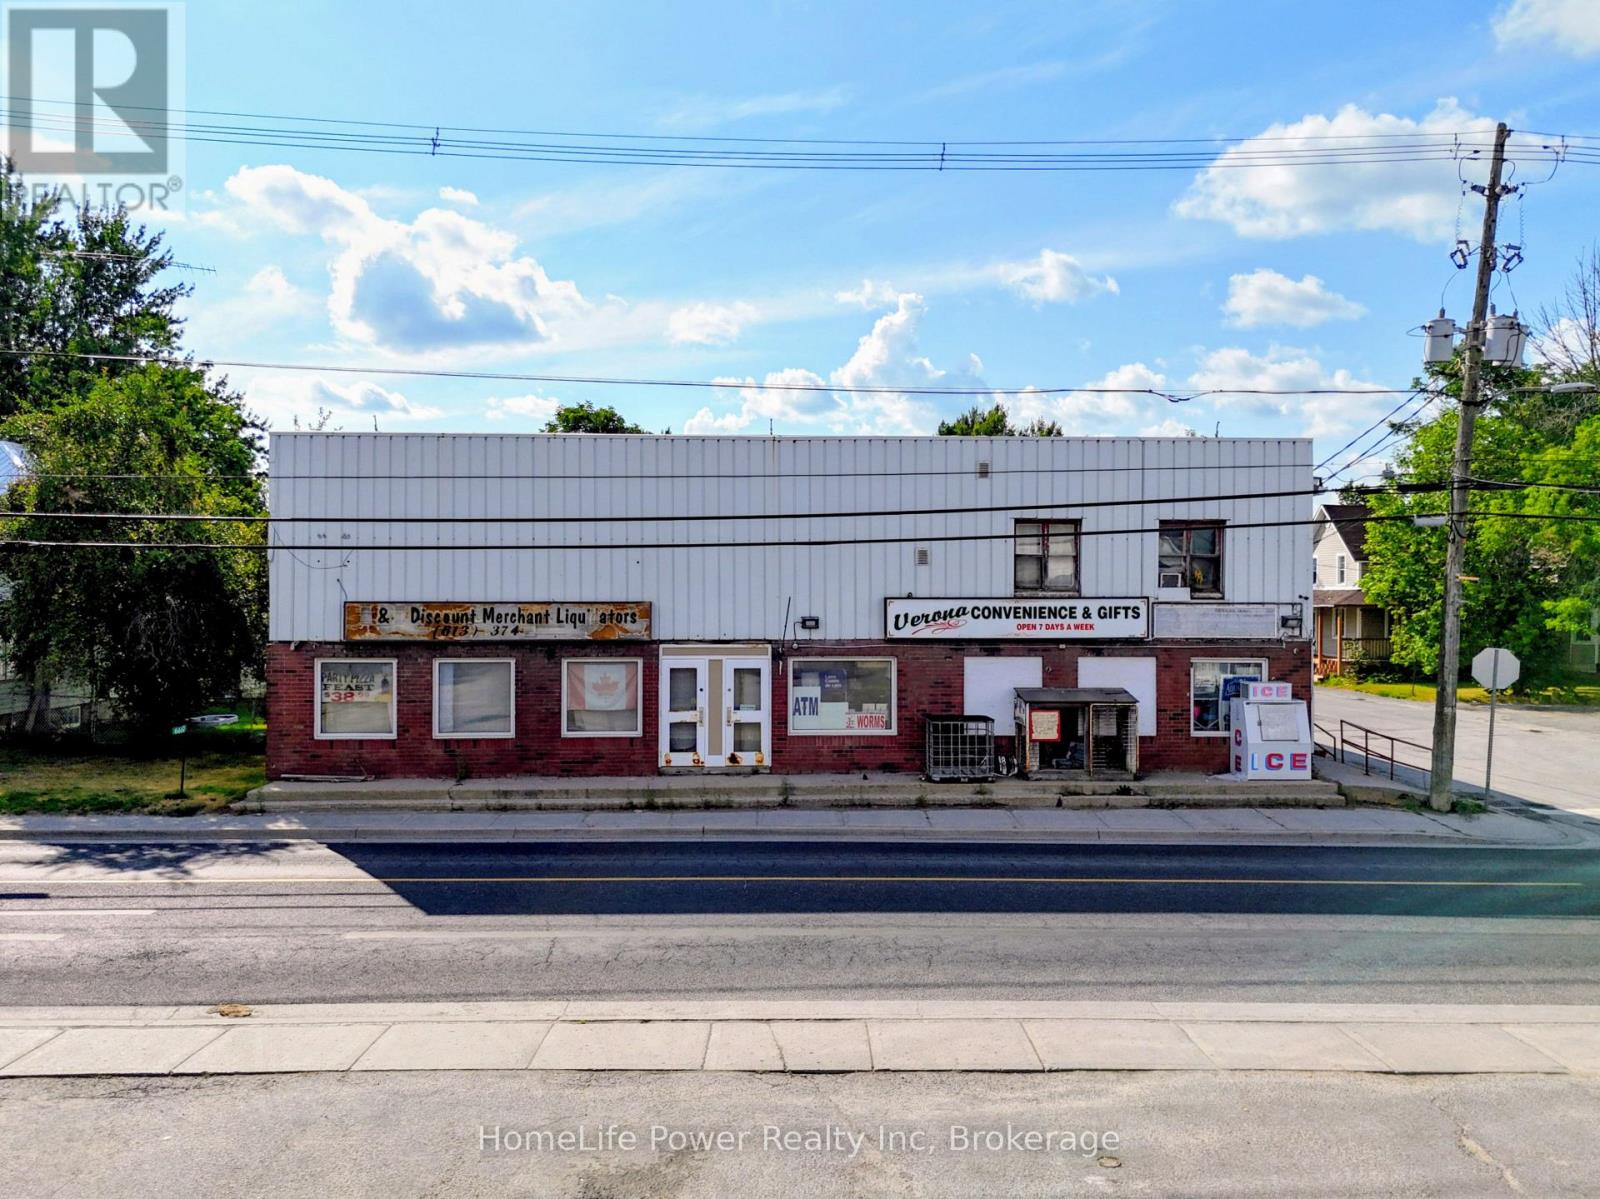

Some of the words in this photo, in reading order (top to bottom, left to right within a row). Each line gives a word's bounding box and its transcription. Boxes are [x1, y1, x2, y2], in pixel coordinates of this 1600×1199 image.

[410, 606, 477, 625] Discount
[482, 606, 551, 625] Merchant
[556, 606, 637, 629] Liquators
[893, 605, 970, 631] Verona
[971, 605, 1078, 620] CONVENIENCE
[1081, 605, 1093, 620] &
[1097, 605, 1141, 620] GIFTS
[1016, 623, 1037, 631] OPEN
[1045, 623, 1065, 631] DAYS
[1066, 623, 1072, 631] A
[1073, 623, 1095, 631] WEEK
[322, 683, 376, 692] FEAST
[1252, 685, 1288, 698] ICE
[792, 696, 819, 716] ATM
[856, 714, 885, 729] WORMS
[1250, 752, 1308, 771] ICE
